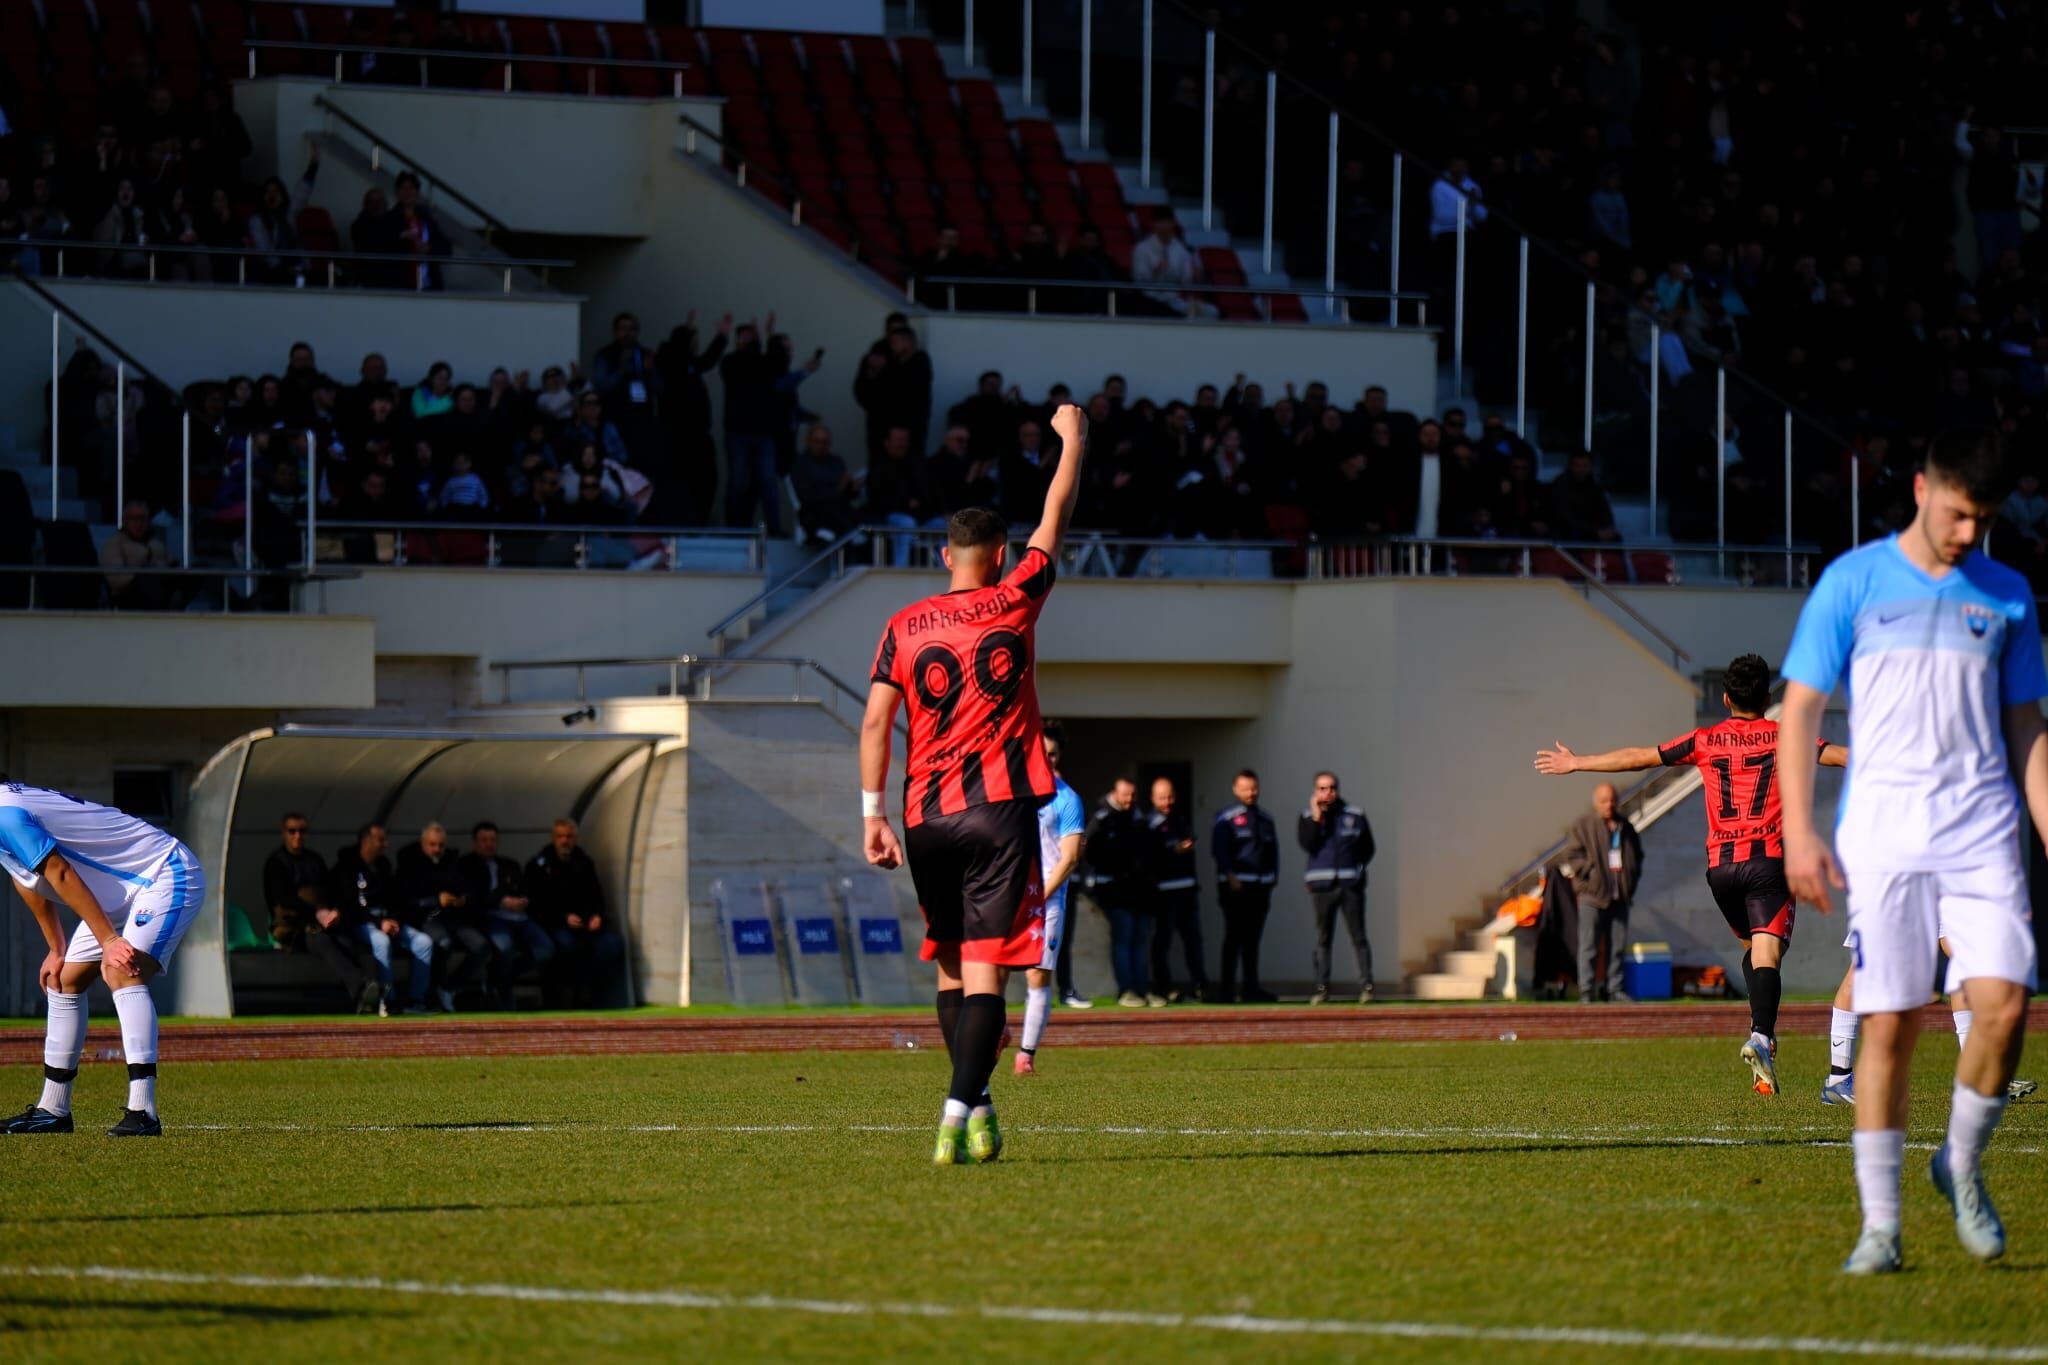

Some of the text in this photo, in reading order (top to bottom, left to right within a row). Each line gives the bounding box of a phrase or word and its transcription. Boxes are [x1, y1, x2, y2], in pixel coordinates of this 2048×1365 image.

[908, 593, 1009, 636] BAFRASPOR
[912, 626, 1027, 741] 99
[1710, 749, 1776, 822] 17
